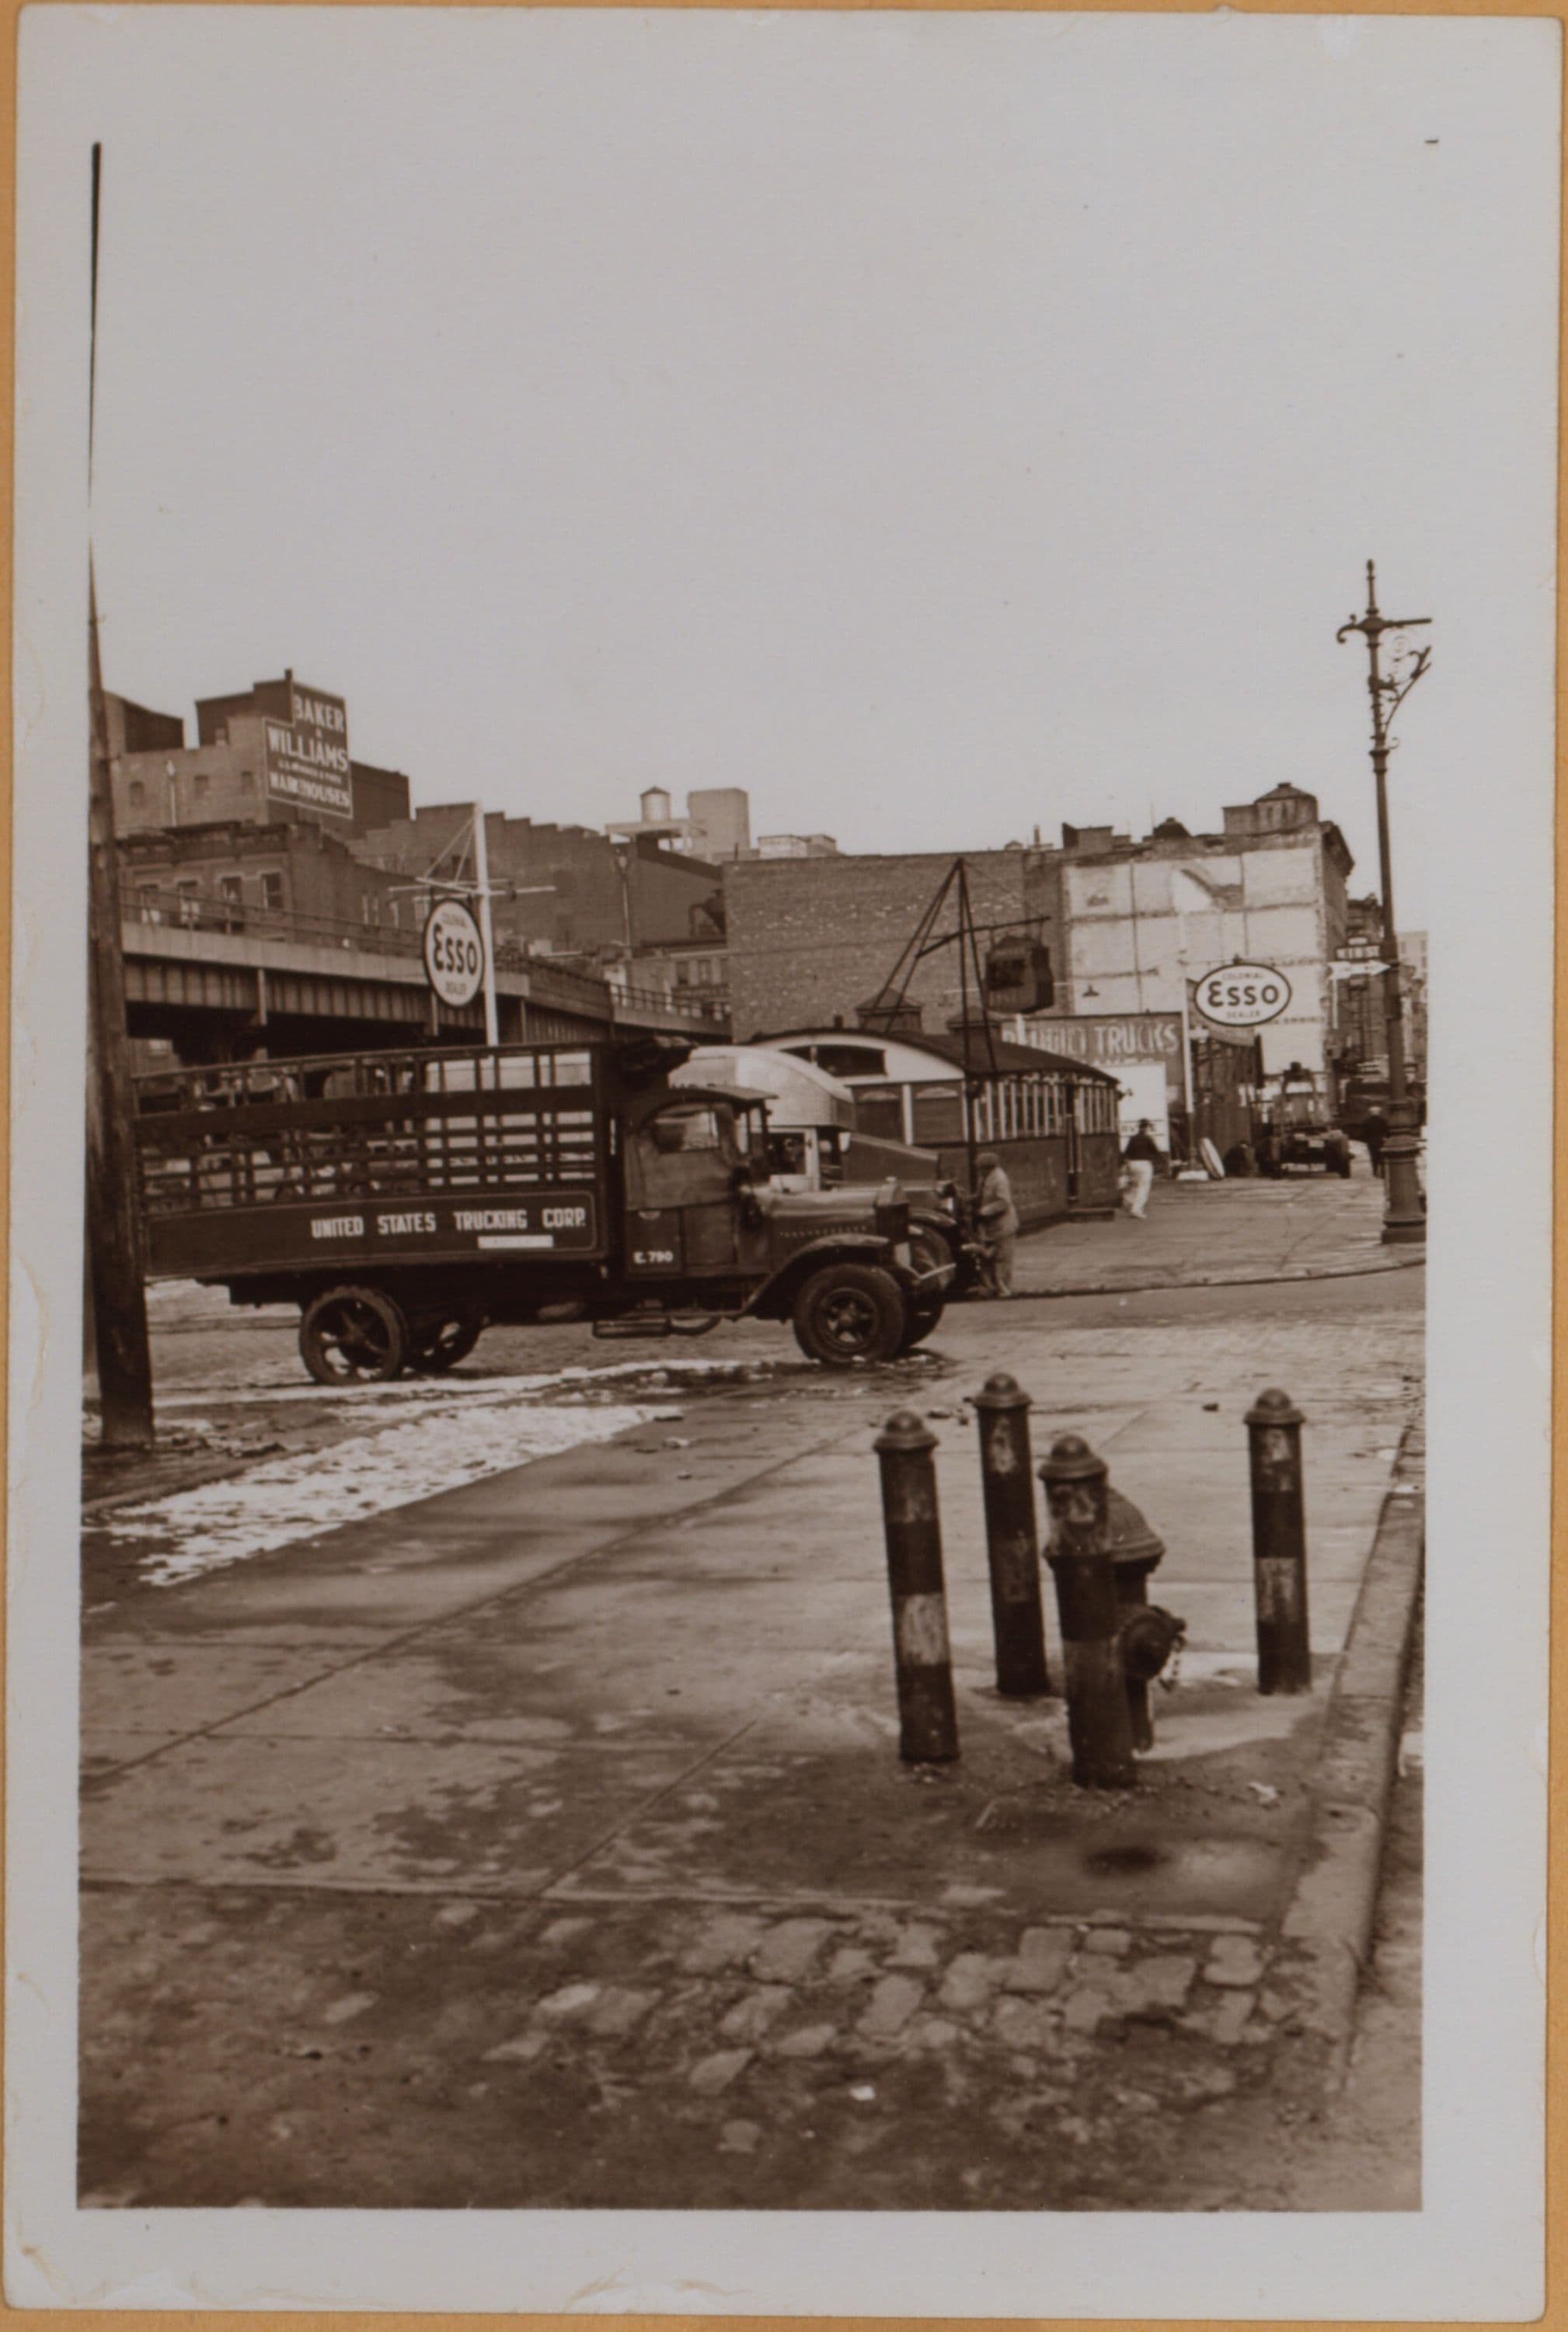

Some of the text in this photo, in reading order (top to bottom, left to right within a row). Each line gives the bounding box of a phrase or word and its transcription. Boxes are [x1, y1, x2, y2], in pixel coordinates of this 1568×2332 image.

[293, 694, 344, 733] BAKER
[267, 727, 349, 772] WILLIAMS
[270, 772, 350, 808] WAREHOUSES
[433, 922, 477, 975] ESSO
[1207, 981, 1279, 1008] ESSO
[1094, 1023, 1179, 1058] TRUCKS
[312, 1216, 364, 1239] UNITED
[377, 1212, 436, 1236] STATES
[453, 1209, 528, 1231] TRUCKING
